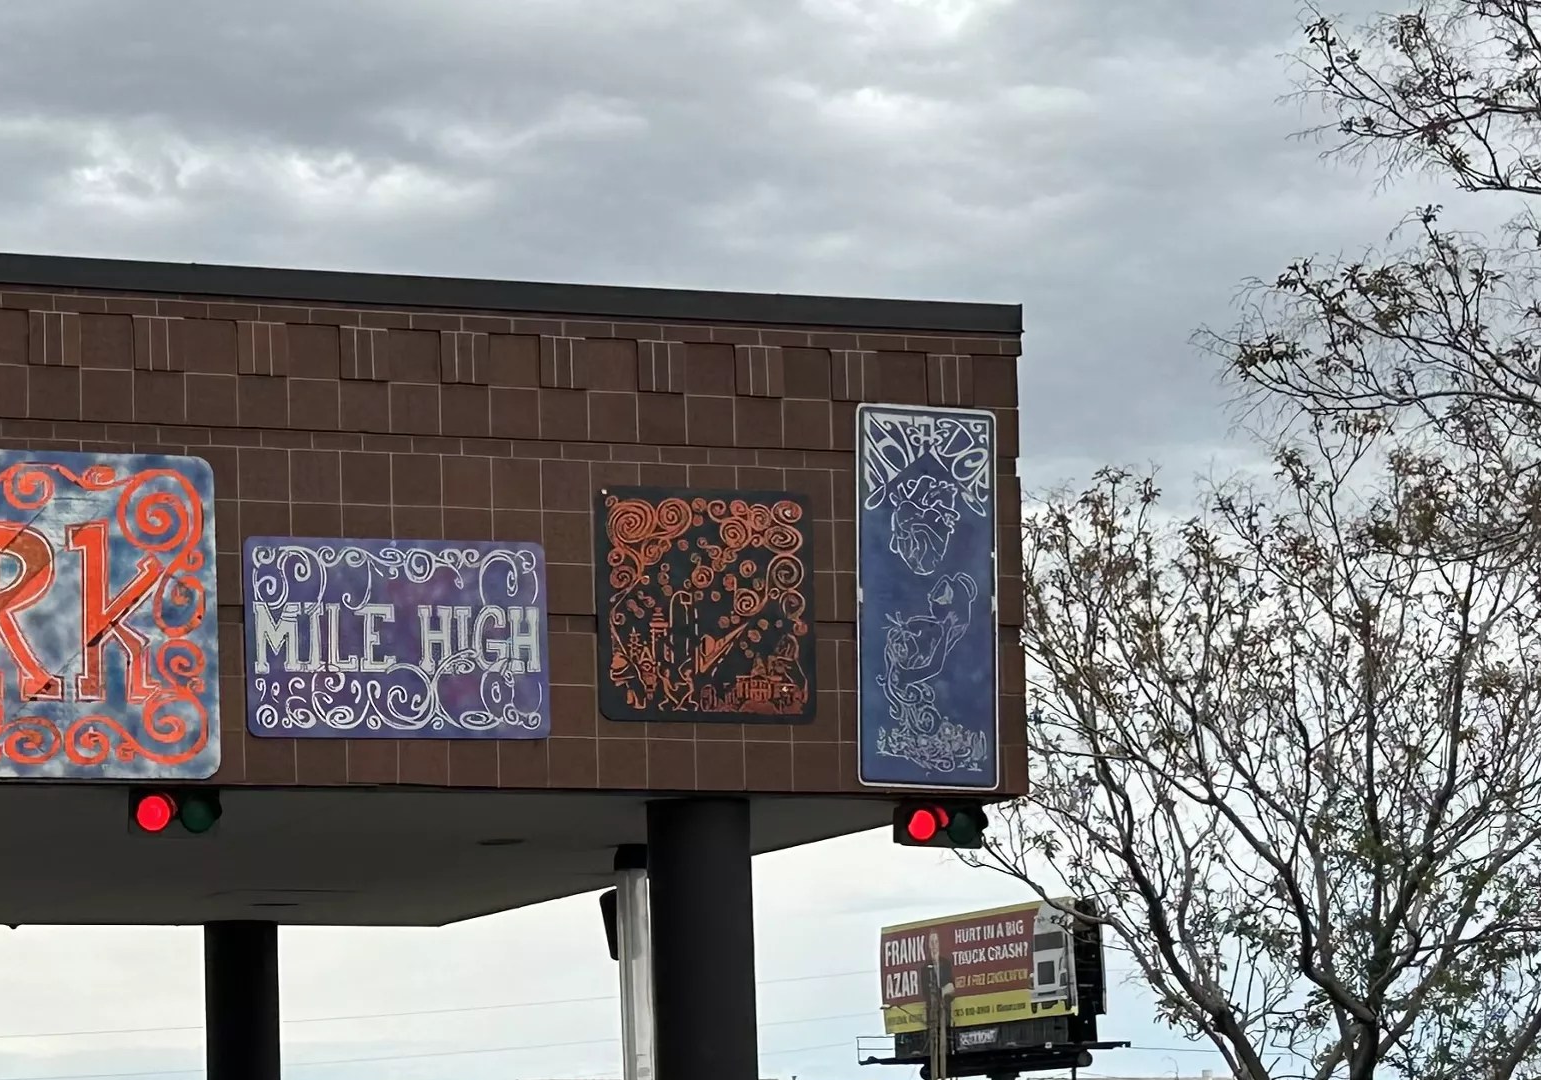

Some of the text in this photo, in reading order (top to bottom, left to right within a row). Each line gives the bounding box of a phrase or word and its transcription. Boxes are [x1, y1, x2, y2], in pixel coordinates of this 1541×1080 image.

[252, 601, 542, 675] MILE HIGH
[954, 919, 1024, 944] HURT IN A BIG
[885, 935, 926, 967] FRANK
[952, 941, 1028, 966] TRUCK CRASH?
[886, 971, 919, 999] AZAR
